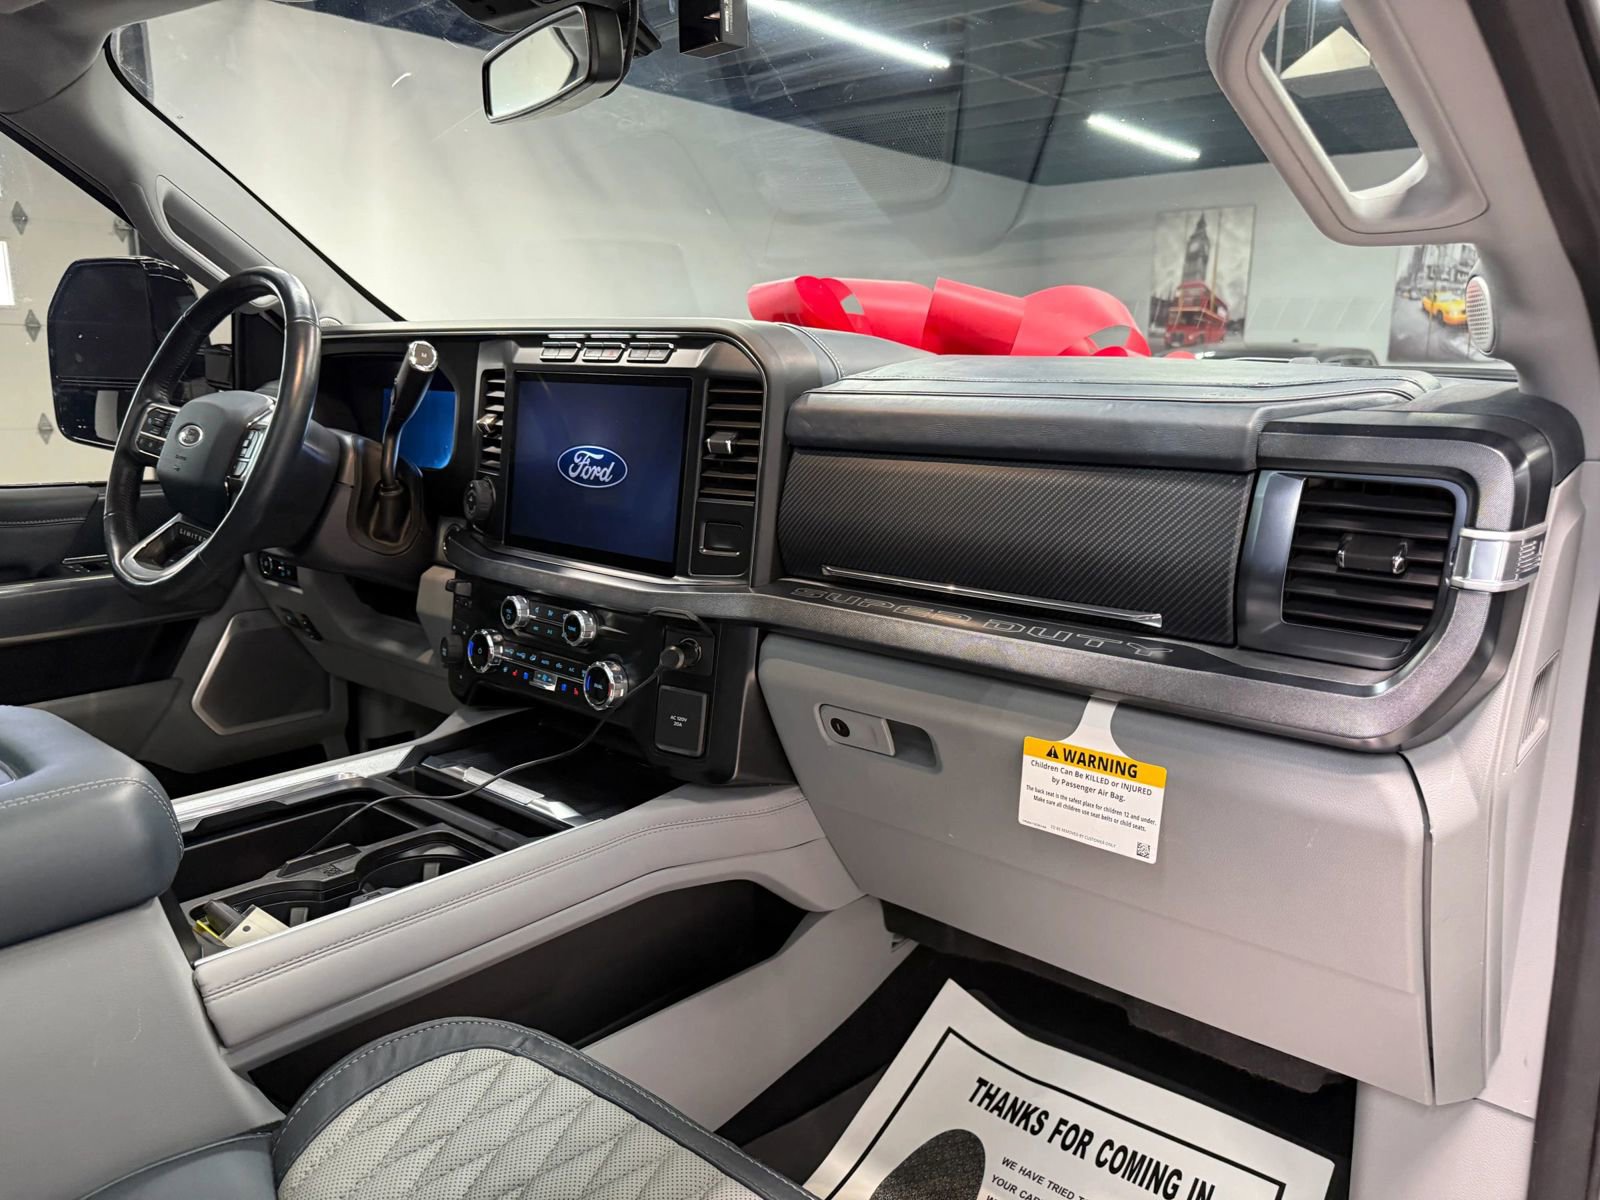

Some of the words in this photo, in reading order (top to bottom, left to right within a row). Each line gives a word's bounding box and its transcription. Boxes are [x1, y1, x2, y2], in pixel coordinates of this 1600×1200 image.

[568, 450, 613, 483] Ford
[790, 587, 972, 623] SUPER
[982, 618, 1174, 657] DUTY
[1030, 759, 1059, 773] Children
[1060, 767, 1073, 777] Can
[1074, 770, 1084, 779] Be
[1085, 773, 1110, 785] KILLED
[1111, 780, 1119, 788] or
[1121, 782, 1153, 796] INJURED
[1063, 747, 1138, 779] WARNING
[1034, 786, 1045, 795] back
[1045, 790, 1055, 798] seat
[1082, 800, 1095, 809] place
[1095, 802, 1103, 810] for
[1103, 805, 1123, 816] children
[1130, 813, 1140, 821] and
[1051, 776, 1061, 786] by
[1061, 778, 1096, 794] Passenger
[1097, 788, 1109, 798] Air
[1110, 791, 1126, 803] Bag.
[1033, 794, 1045, 803] Make
[1090, 811, 1101, 820] seat
[1119, 819, 1131, 828] child
[968, 1076, 1050, 1136] THANKS
[1047, 1117, 1094, 1160] FOR
[1094, 1138, 1183, 1200] COMING
[991, 1174, 1018, 1195] YOUR
[1001, 1156, 1019, 1171] WE
[1018, 1166, 1046, 1186] HAVE
[1046, 1180, 1076, 1200] TRIED
